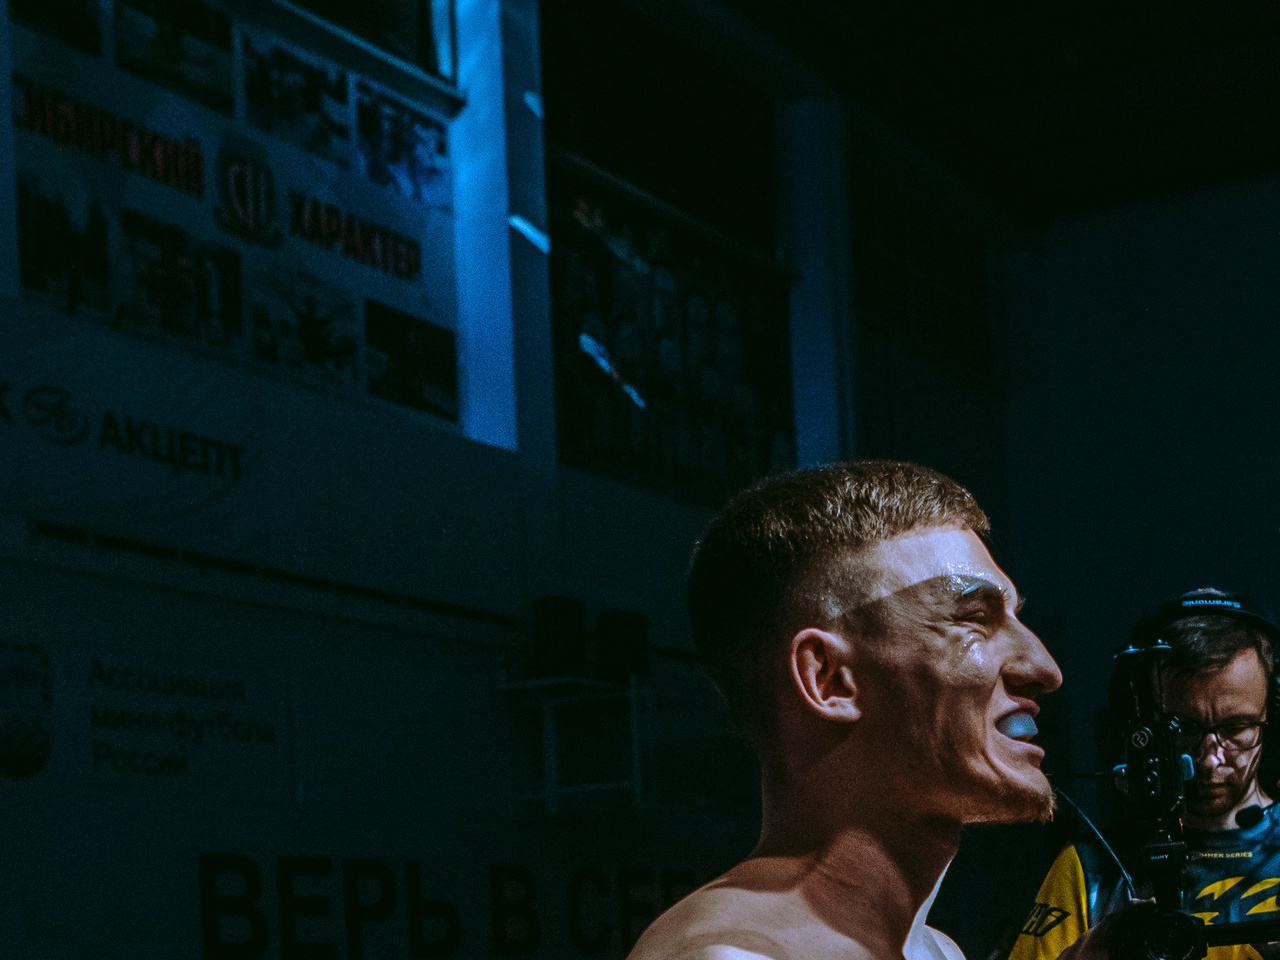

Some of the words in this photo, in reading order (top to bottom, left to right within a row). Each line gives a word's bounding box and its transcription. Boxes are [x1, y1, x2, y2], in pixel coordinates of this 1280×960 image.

[288, 189, 421, 279] ХАРАКТЕР
[99, 411, 246, 482] АКЦЕПТ
[93, 740, 188, 775] России
[489, 863, 541, 957] В
[567, 863, 725, 957] СЕ
